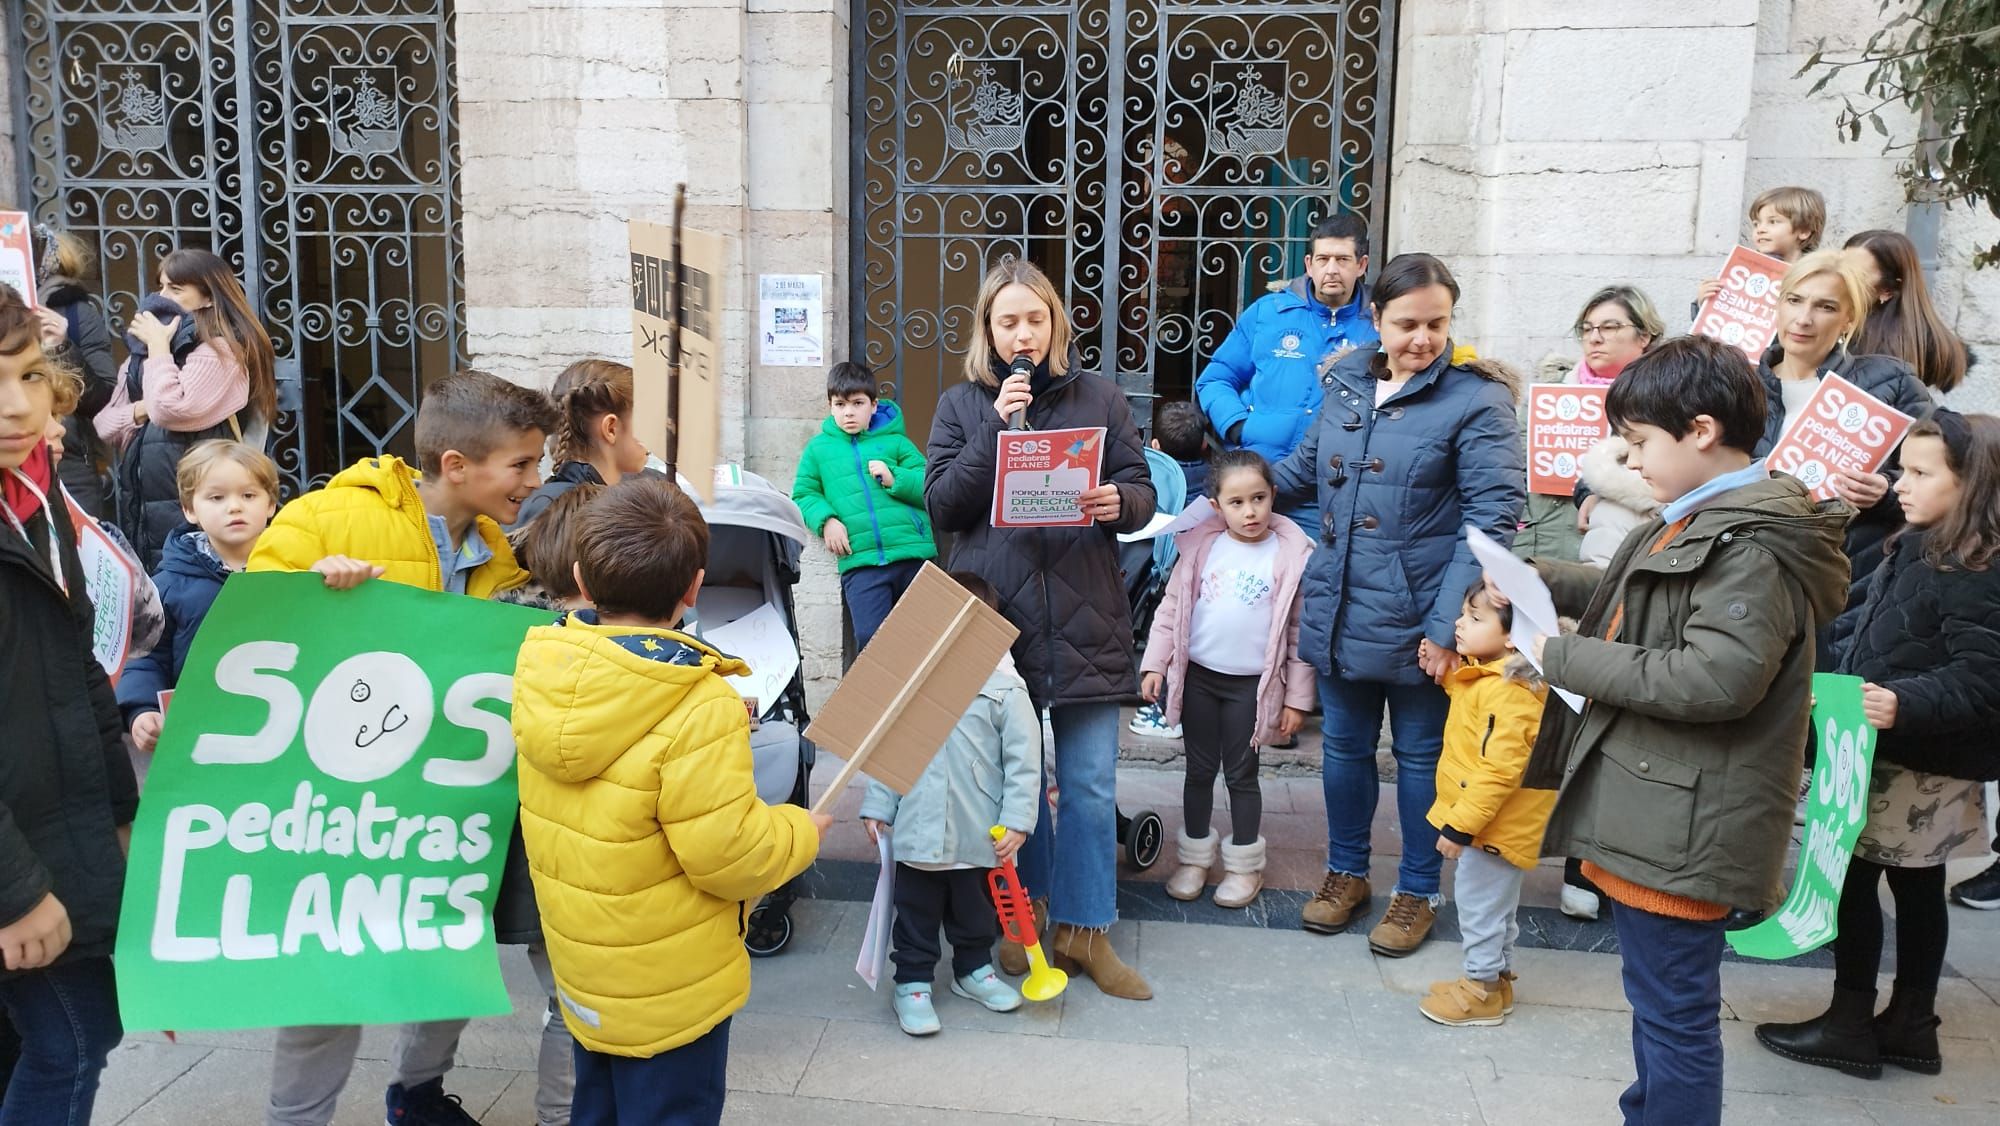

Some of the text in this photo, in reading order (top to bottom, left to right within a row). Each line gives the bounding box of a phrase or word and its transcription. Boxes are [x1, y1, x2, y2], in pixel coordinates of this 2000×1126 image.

[1535, 393, 1602, 422] SOS
[1816, 388, 1892, 448] SOS
[1008, 439, 1052, 455] SOS
[1534, 422, 1600, 437] pediatras
[1802, 415, 1872, 464] pediatras
[1008, 455, 1051, 463] pediatras
[1011, 489, 1049, 497] PORQUE
[1040, 504, 1078, 512] SALUD
[192, 640, 518, 787] SOS
[1819, 716, 1868, 826] SOS
[160, 780, 494, 864] pediatras
[151, 871, 490, 963] LLANES
